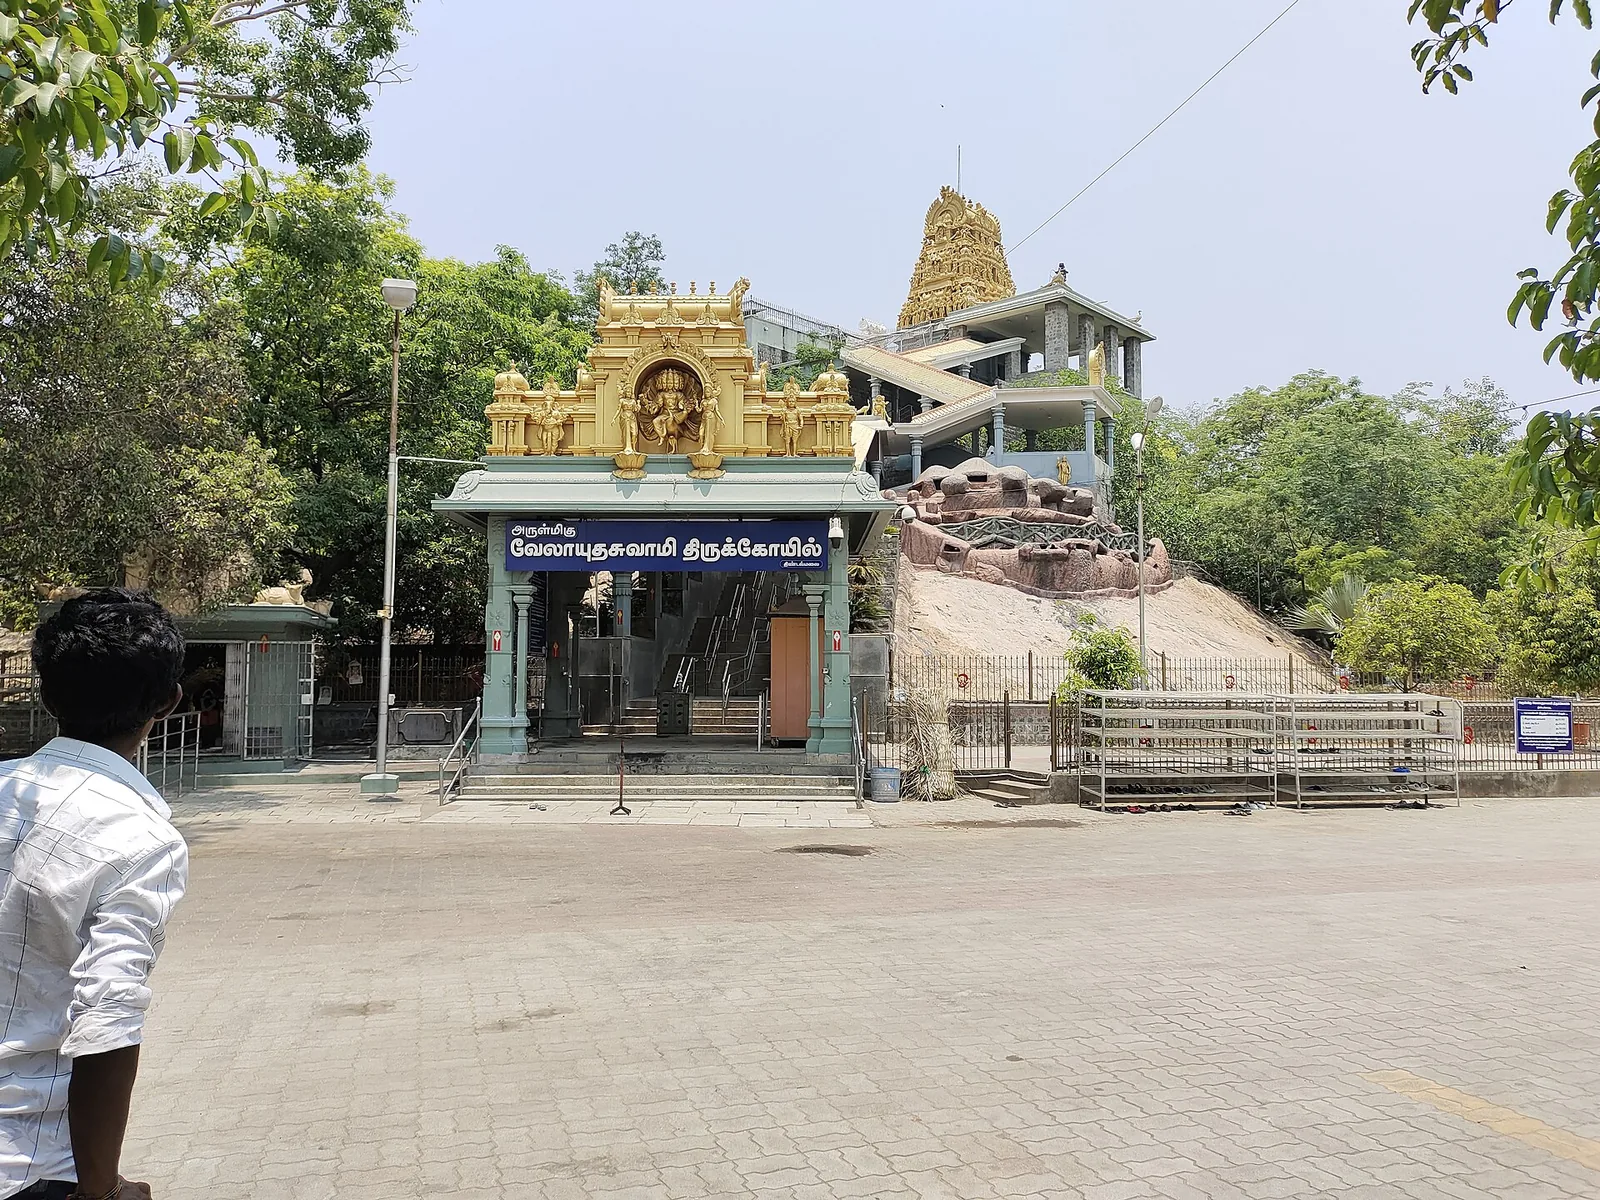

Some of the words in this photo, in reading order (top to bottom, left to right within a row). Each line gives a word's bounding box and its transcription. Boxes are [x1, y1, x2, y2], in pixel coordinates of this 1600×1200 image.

[511, 523, 576, 538] அருள்மிகு
[510, 538, 677, 562] வேலாயுதசுவாமி
[682, 537, 823, 561] திருக்கோயில்
